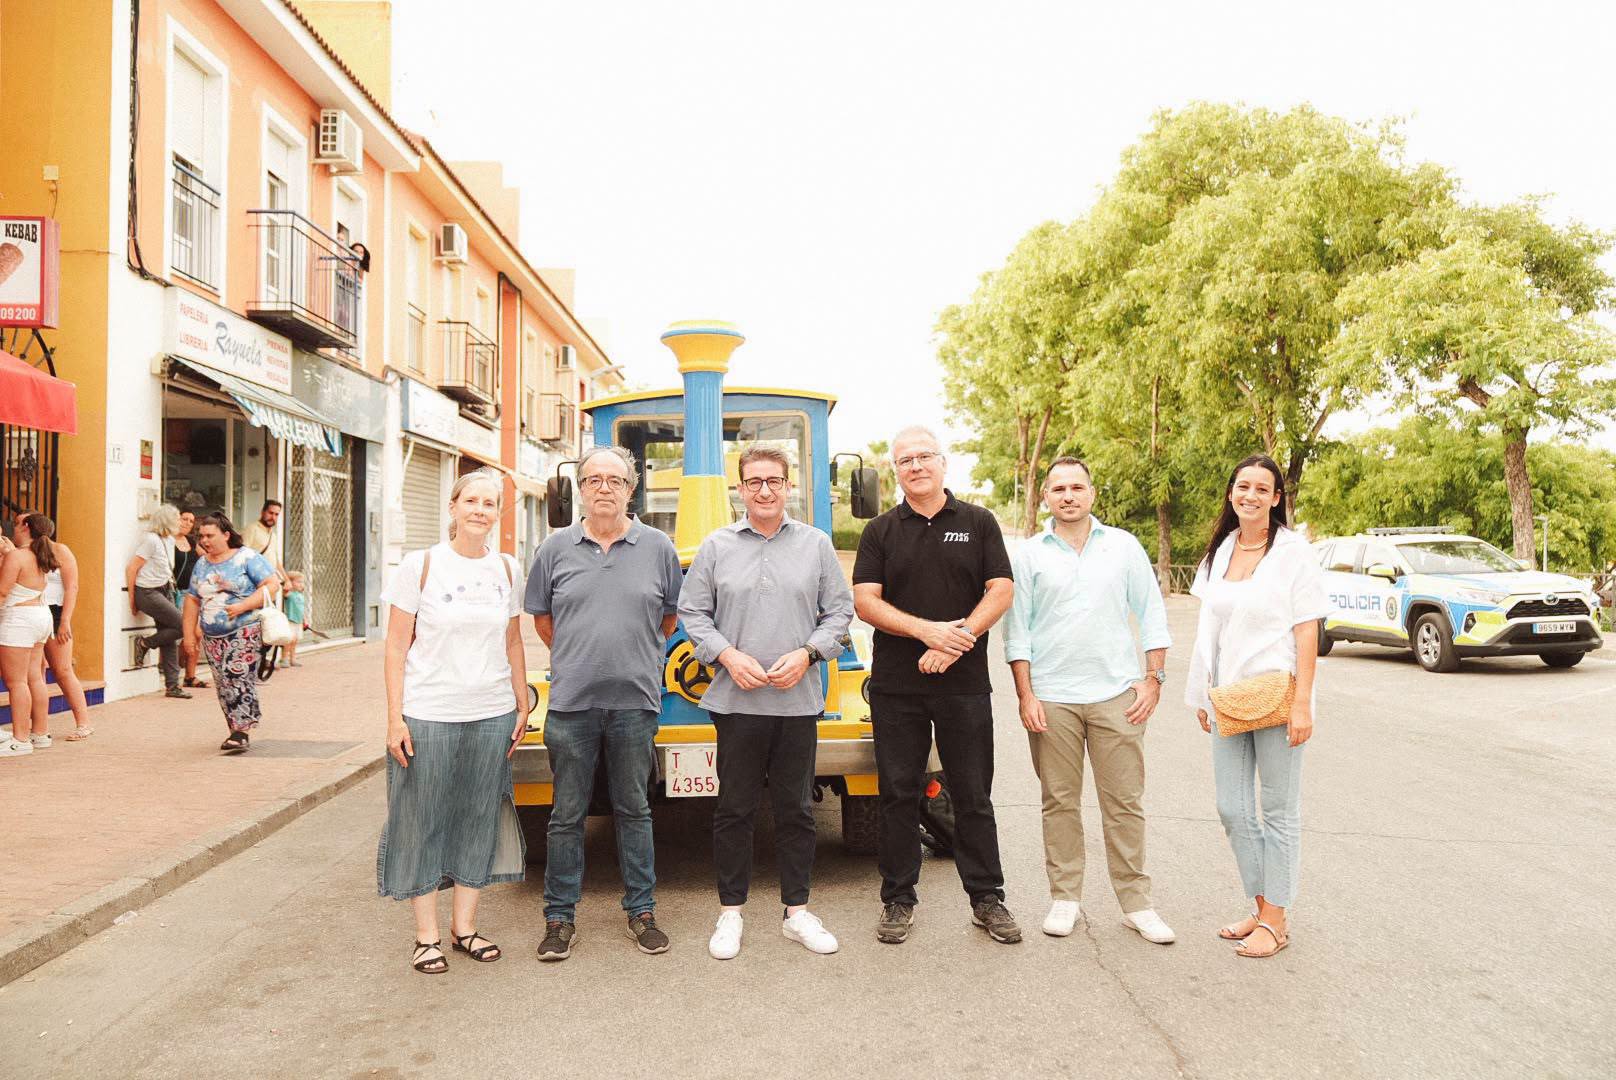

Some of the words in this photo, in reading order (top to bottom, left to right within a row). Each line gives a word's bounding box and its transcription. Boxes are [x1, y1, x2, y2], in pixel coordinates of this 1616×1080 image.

[5, 223, 37, 243] KEBAB
[1329, 594, 1381, 611] POLICIA
[672, 752, 680, 769] T
[706, 751, 714, 768] V
[672, 776, 715, 793] 4355
